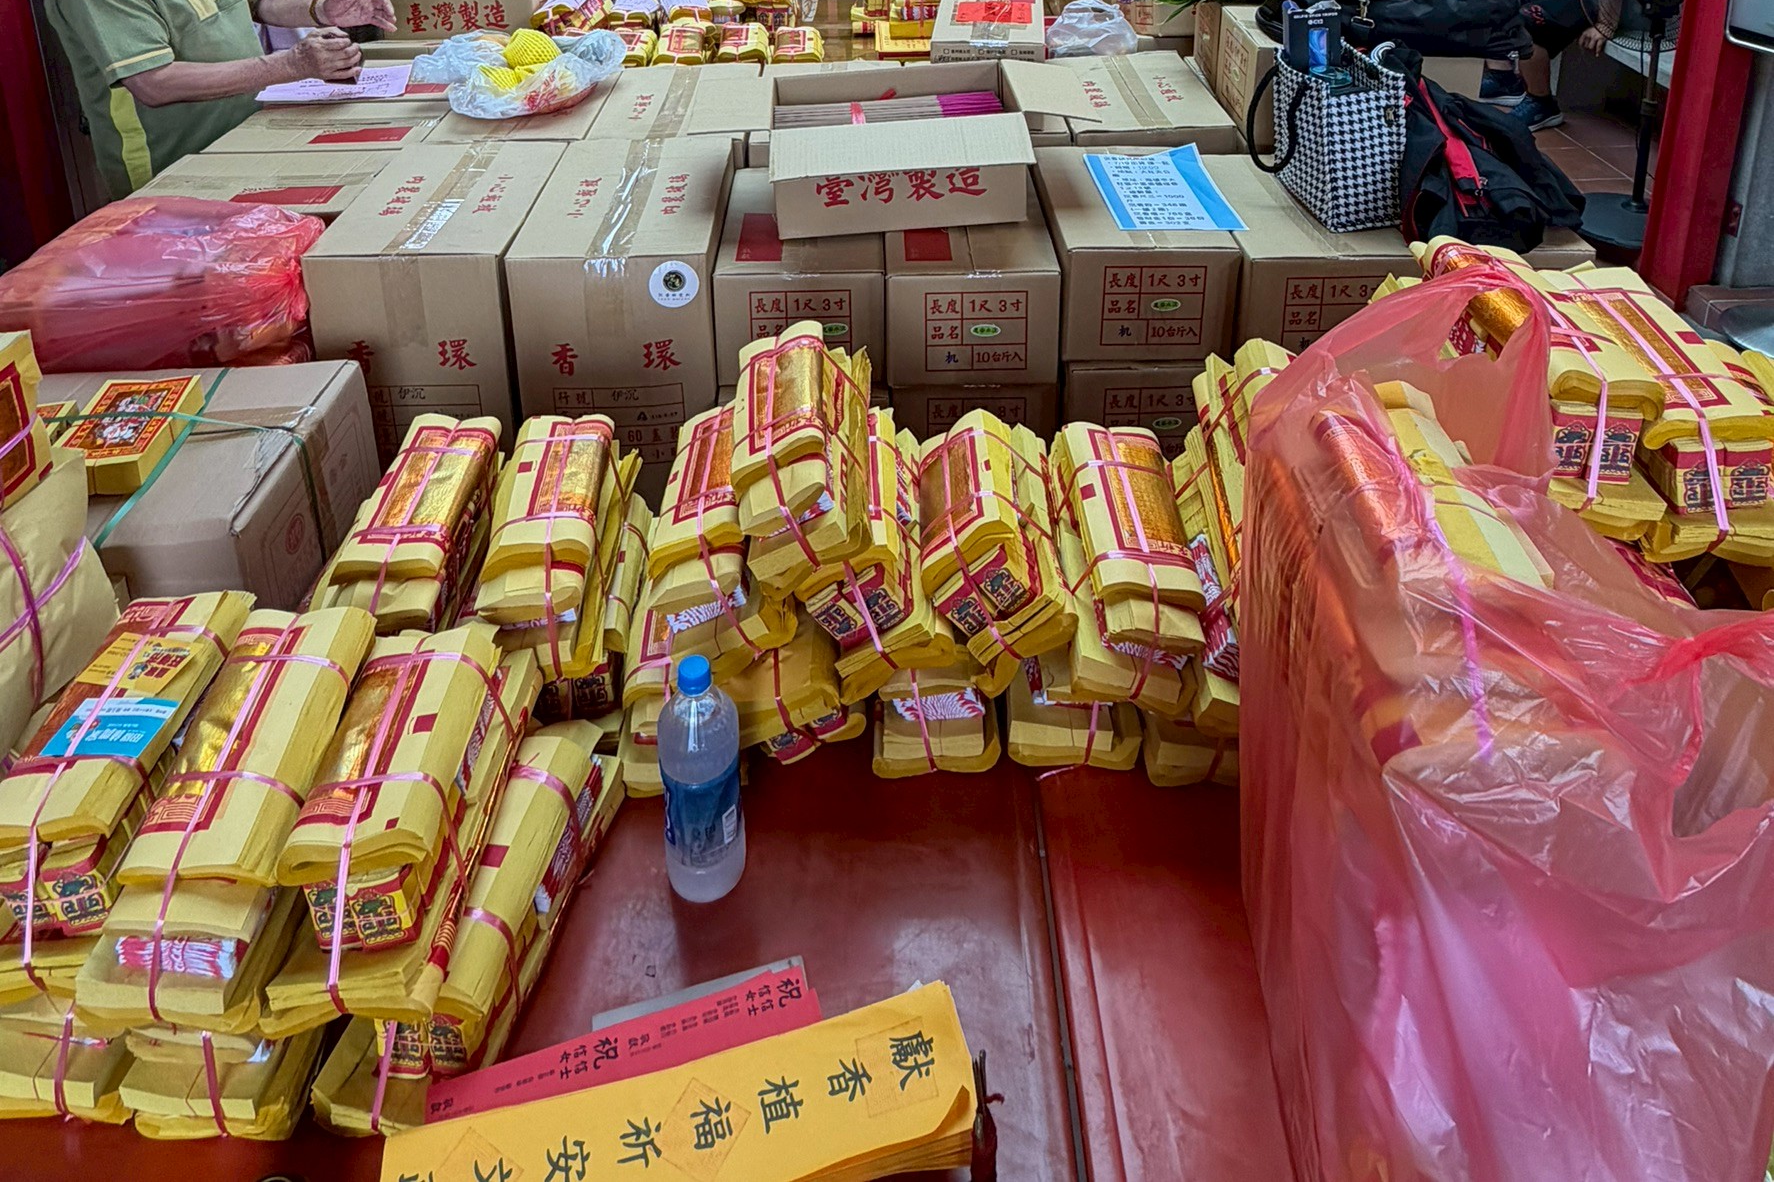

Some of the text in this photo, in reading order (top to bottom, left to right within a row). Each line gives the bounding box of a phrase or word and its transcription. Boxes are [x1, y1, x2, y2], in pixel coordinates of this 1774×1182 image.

[406, 0, 510, 33] 臺灣製造
[816, 167, 988, 208] 臺灣製造
[567, 177, 603, 219] 小心輕放
[1109, 273, 1202, 288] 長度 1尺 3寸
[1290, 284, 1320, 299] 長度
[1330, 284, 1352, 298] 1尺
[755, 298, 846, 313] 長度 1尺 3寸
[930, 299, 1022, 315] 長度 1尺 3寸
[1108, 300, 1136, 314] 品名
[1289, 311, 1317, 325] 品名
[930, 325, 959, 340] 品名
[1150, 326, 1198, 338] 10台斤入
[346, 339, 478, 375] 香 環
[551, 339, 682, 376] 香 環
[976, 351, 1024, 363] 10台斤入
[1109, 394, 1138, 409] 長度
[746, 985, 771, 1002] 信女
[776, 978, 802, 1008] 祝
[748, 999, 774, 1016] 信士
[560, 1045, 588, 1064] 信女
[593, 1036, 619, 1070] 祝
[560, 1061, 588, 1079] 信士
[399, 1030, 936, 1182] 獻香植福祈安文
